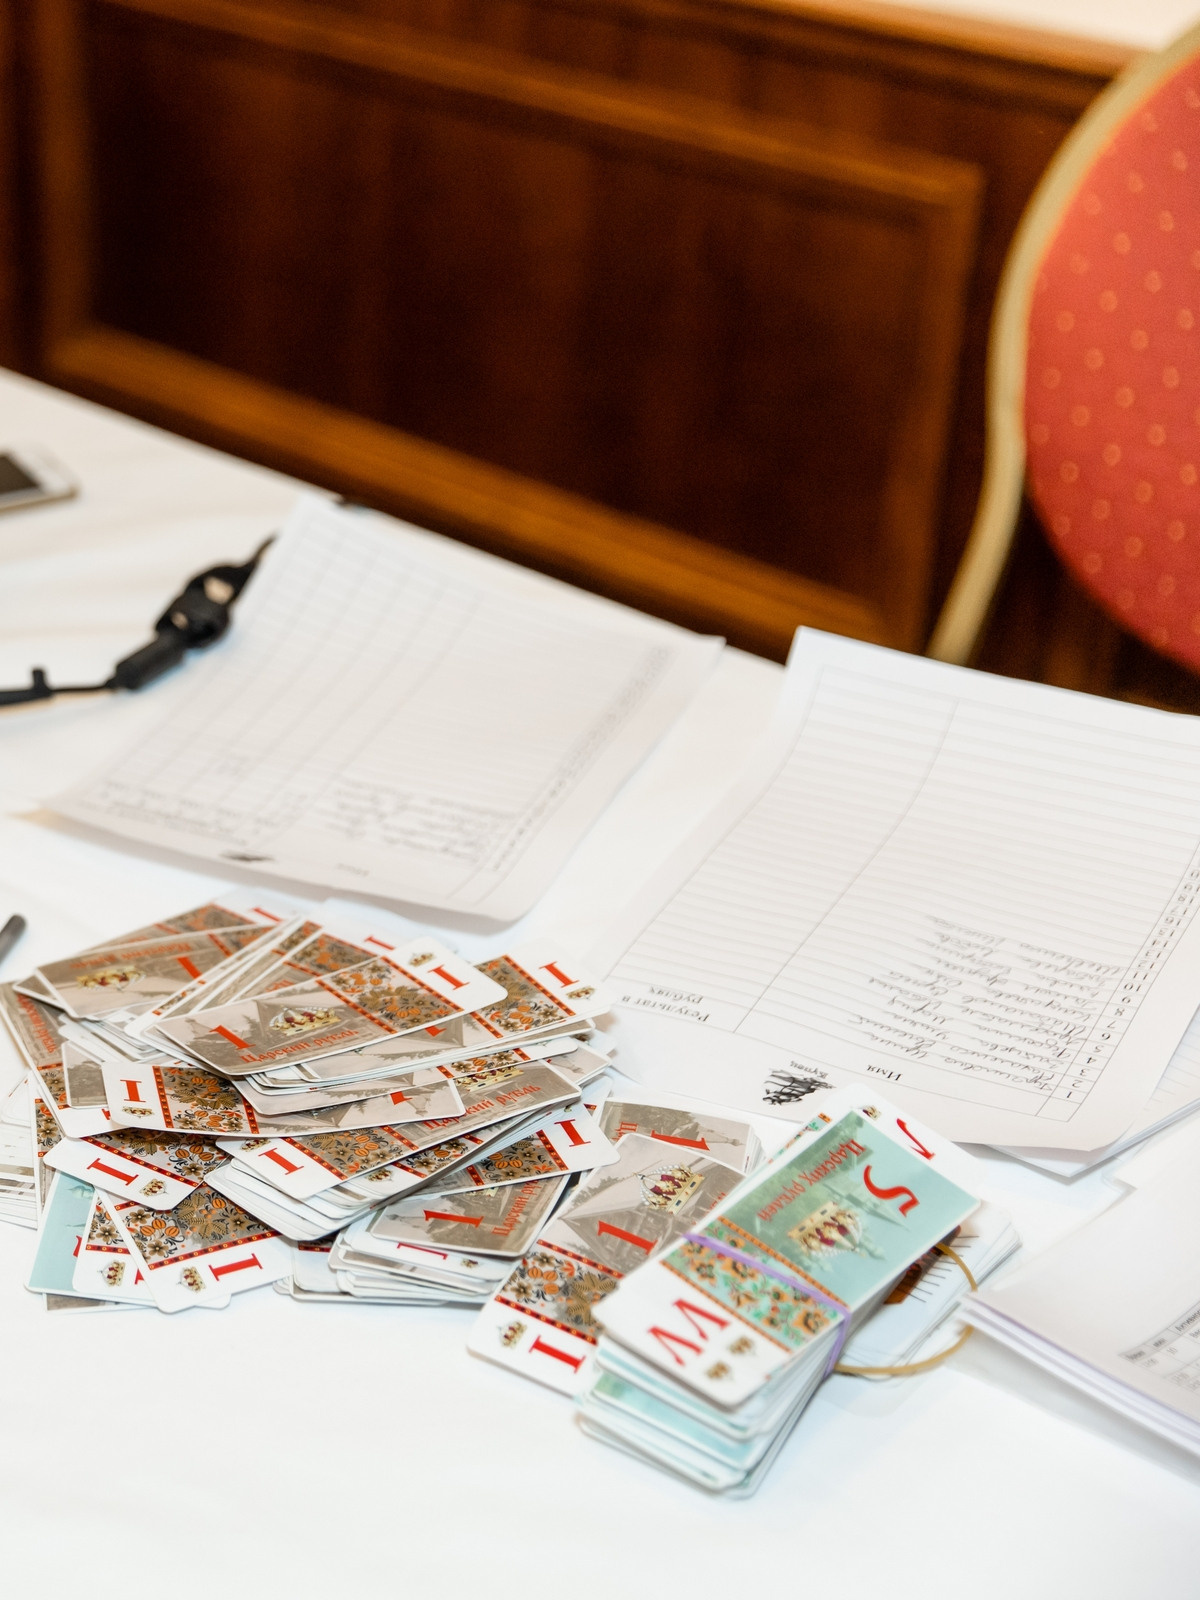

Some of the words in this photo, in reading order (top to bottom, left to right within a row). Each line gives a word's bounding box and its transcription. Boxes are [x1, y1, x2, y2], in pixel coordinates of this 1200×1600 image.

[1123, 982, 1142, 992] 10
[1114, 1007, 1125, 1017] 8
[1106, 1020, 1117, 1030] 7
[1101, 1032, 1111, 1041] 6
[1094, 1044, 1105, 1053] 5
[1086, 1056, 1097, 1064] 4
[866, 1064, 903, 1081] Имя
[1079, 1067, 1091, 1076] 3
[1072, 1079, 1084, 1088] 2
[863, 1164, 921, 1218] 5
